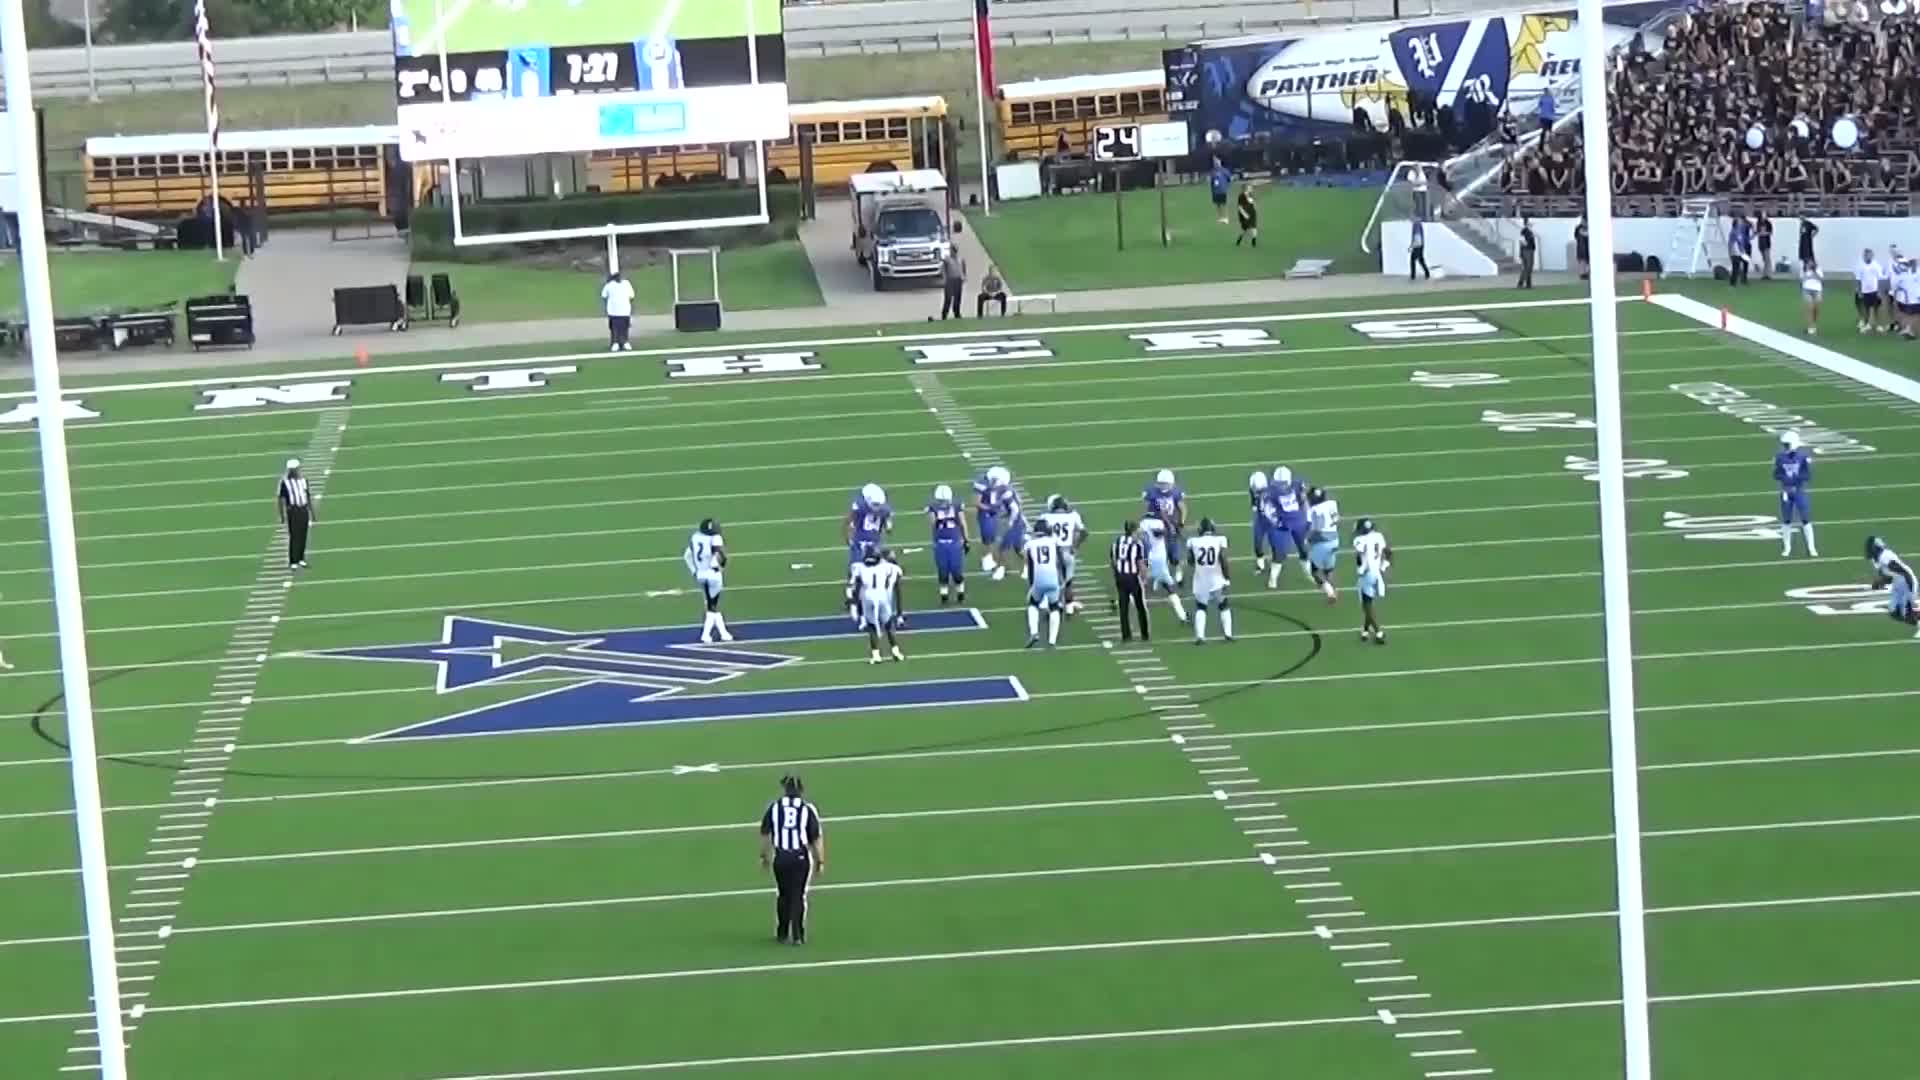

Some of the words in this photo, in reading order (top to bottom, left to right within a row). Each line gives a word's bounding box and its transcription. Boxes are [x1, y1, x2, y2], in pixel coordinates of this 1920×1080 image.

[1260, 69, 1378, 95] PANTHER
[1097, 127, 1138, 157] 24
[1052, 522, 1069, 541] 95
[1036, 546, 1050, 564] 19
[1197, 547, 1216, 566] 20
